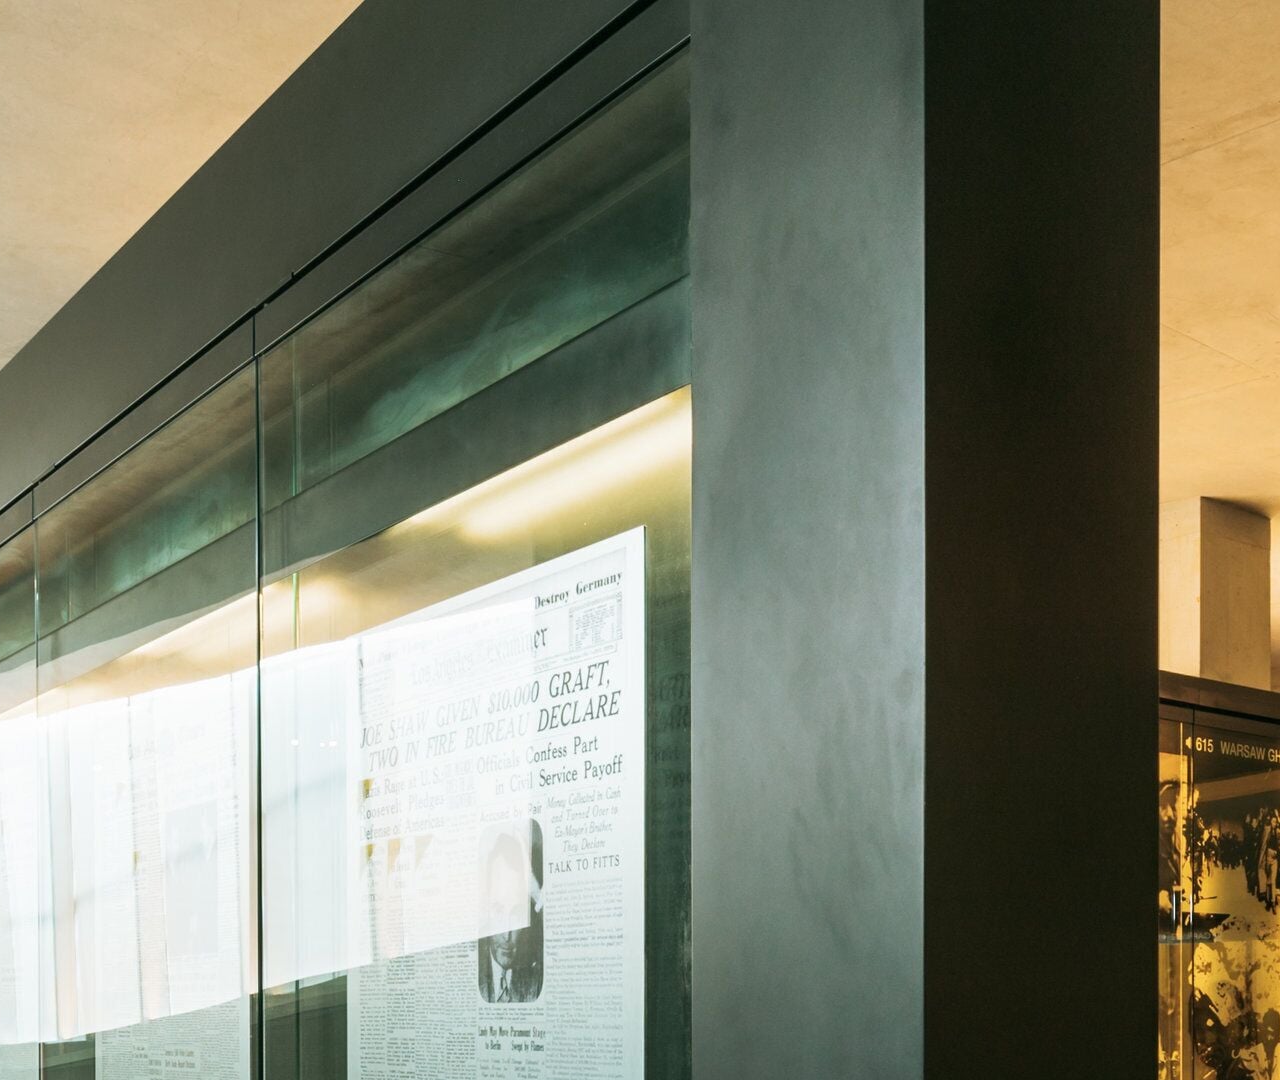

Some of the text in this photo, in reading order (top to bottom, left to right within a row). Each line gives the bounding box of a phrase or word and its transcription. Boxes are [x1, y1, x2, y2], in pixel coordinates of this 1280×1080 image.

[534, 572, 622, 610] Destroy Germany
[360, 723, 383, 750] JOE
[436, 695, 480, 729] GIVEN
[549, 660, 610, 698] GRAFT,
[368, 690, 621, 773] TWO IN FIRE BUREAU DECLARE
[526, 742, 567, 765] Confess
[574, 735, 599, 755] Part
[1196, 737, 1214, 753] 615
[1220, 740, 1266, 760] WARSAW
[495, 754, 623, 795] in Civil Service Payoff
[548, 854, 620, 873] TALK TO FITTS
